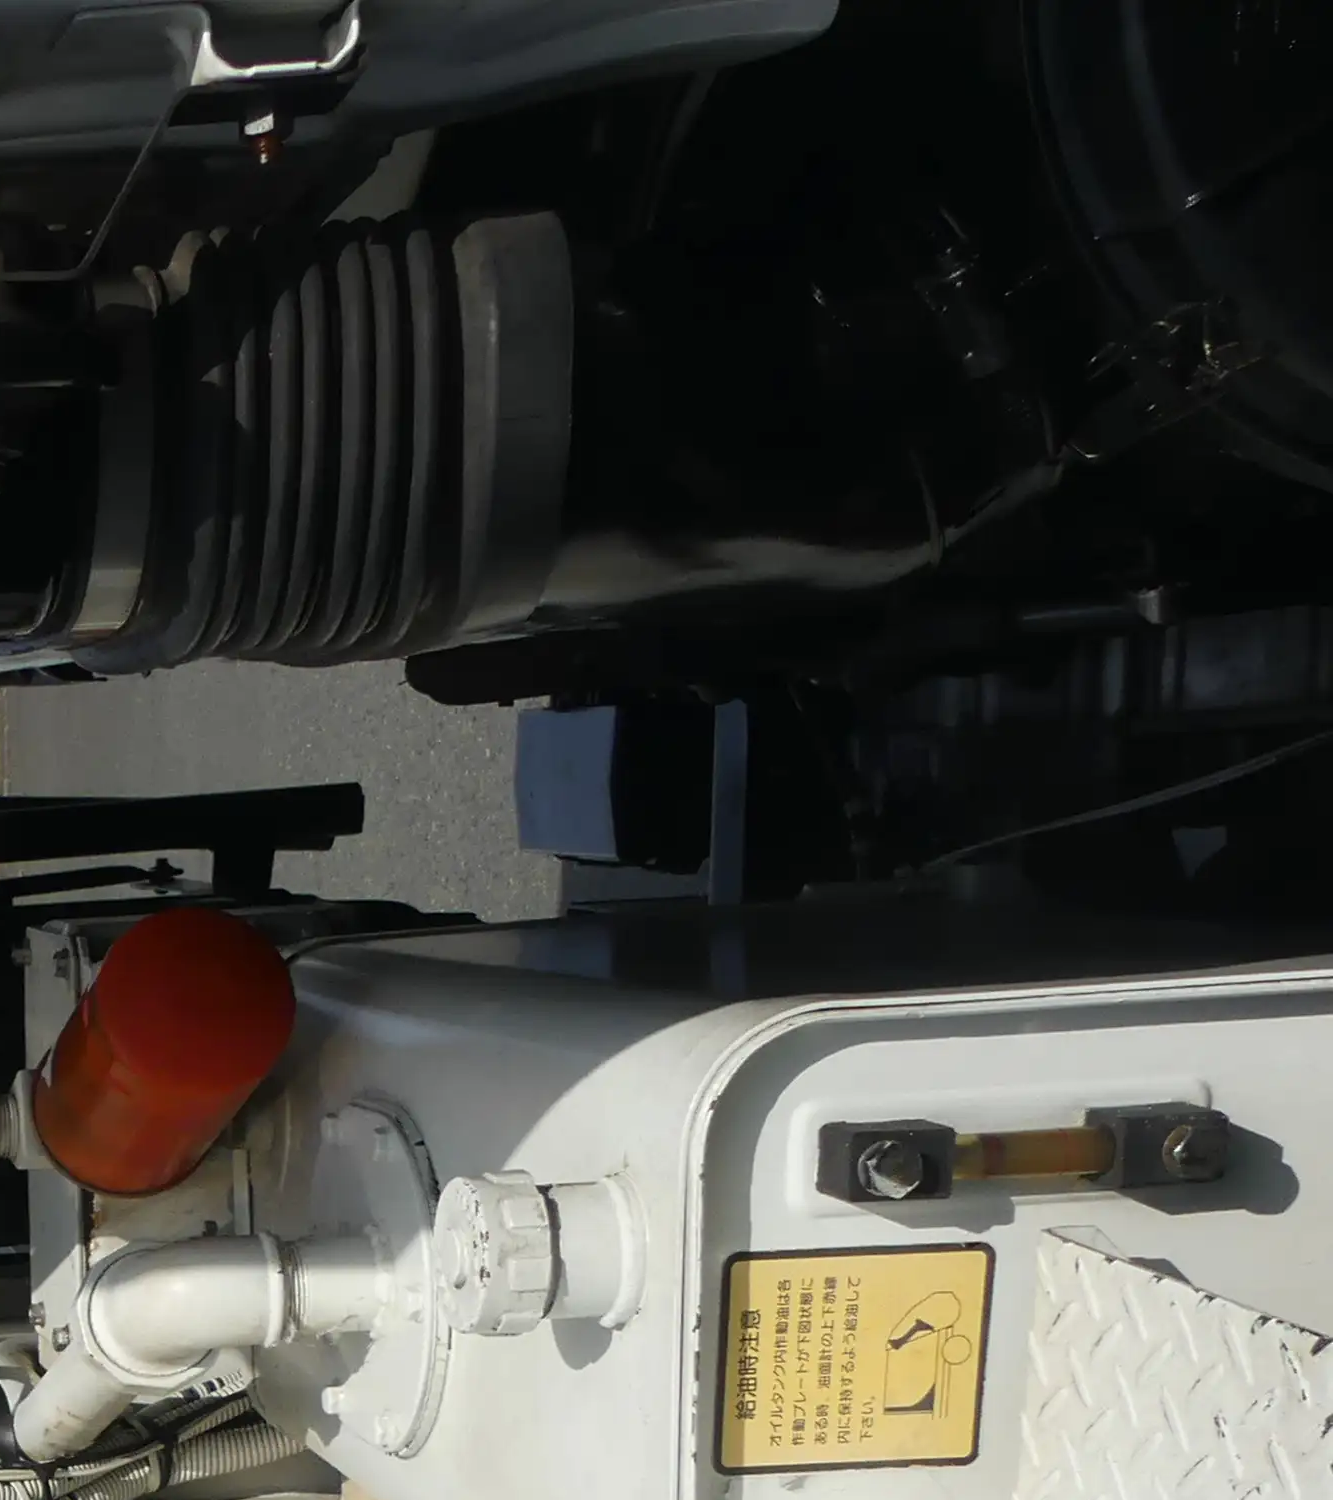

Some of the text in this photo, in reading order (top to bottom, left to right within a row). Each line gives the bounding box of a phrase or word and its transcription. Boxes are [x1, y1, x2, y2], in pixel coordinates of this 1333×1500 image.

[735, 1309, 761, 1420] 給油時注意
[770, 1279, 791, 1447] オイルタンク内作動油は各
[792, 1278, 814, 1446] 作動プレートが下図状態に
[837, 1276, 861, 1444] 内に保持するよう給油して
[859, 1396, 876, 1442] 下さい。
